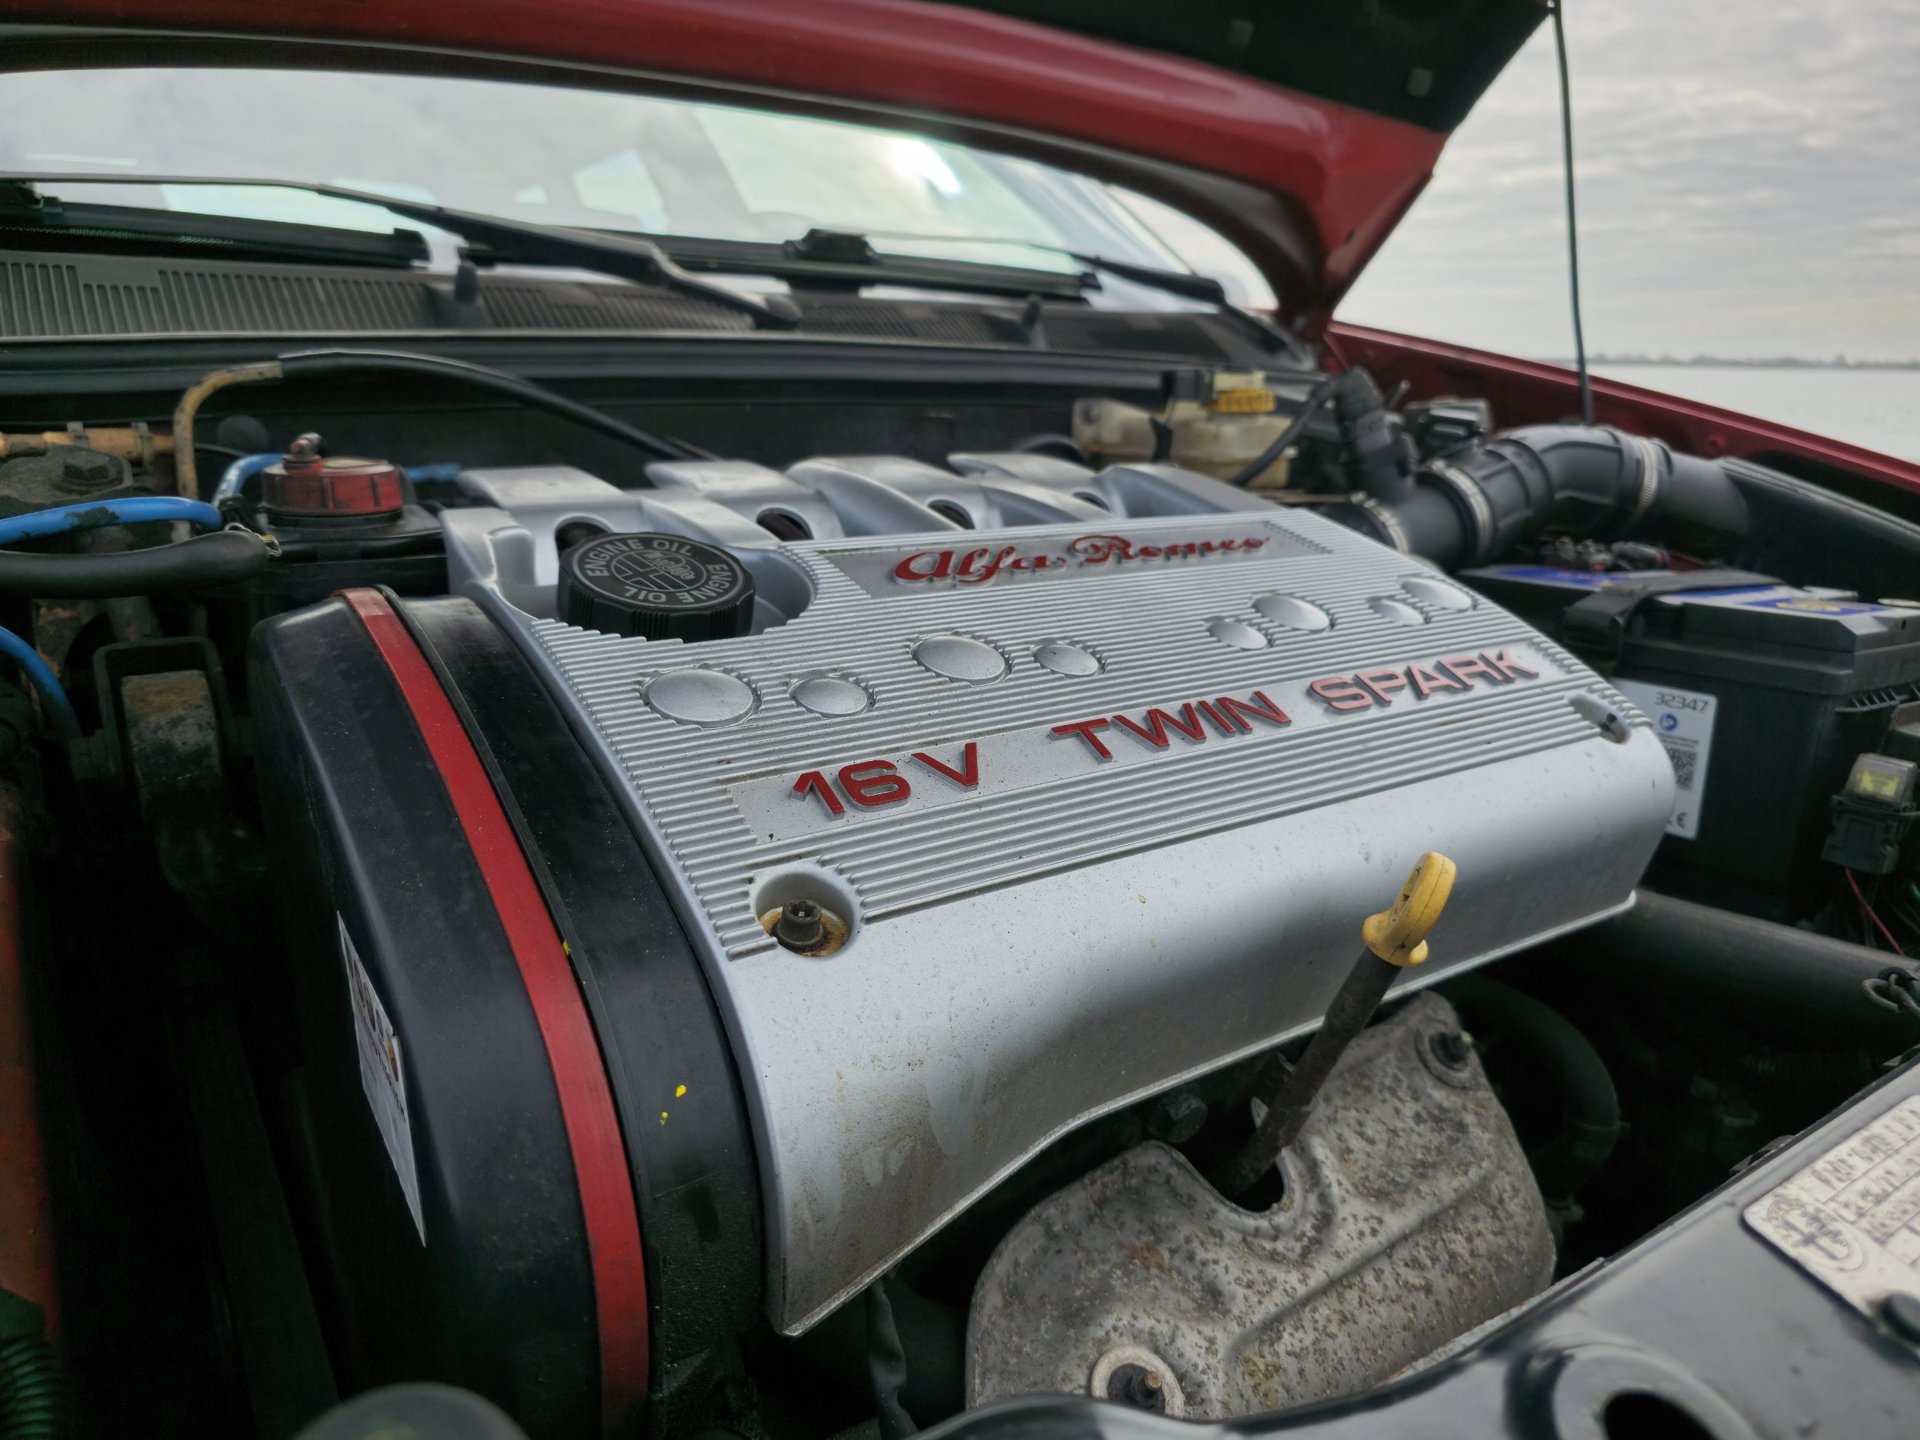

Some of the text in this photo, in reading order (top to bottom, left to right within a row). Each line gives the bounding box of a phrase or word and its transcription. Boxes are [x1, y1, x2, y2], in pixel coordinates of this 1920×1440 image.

[584, 538, 693, 577] ENGINE OIL
[894, 534, 1271, 587] Alfa Romeo
[624, 563, 732, 603] ENGINE OIL
[1051, 690, 1291, 763] TWIN
[1307, 649, 1539, 711] SPARK
[1654, 690, 1709, 713] 32347
